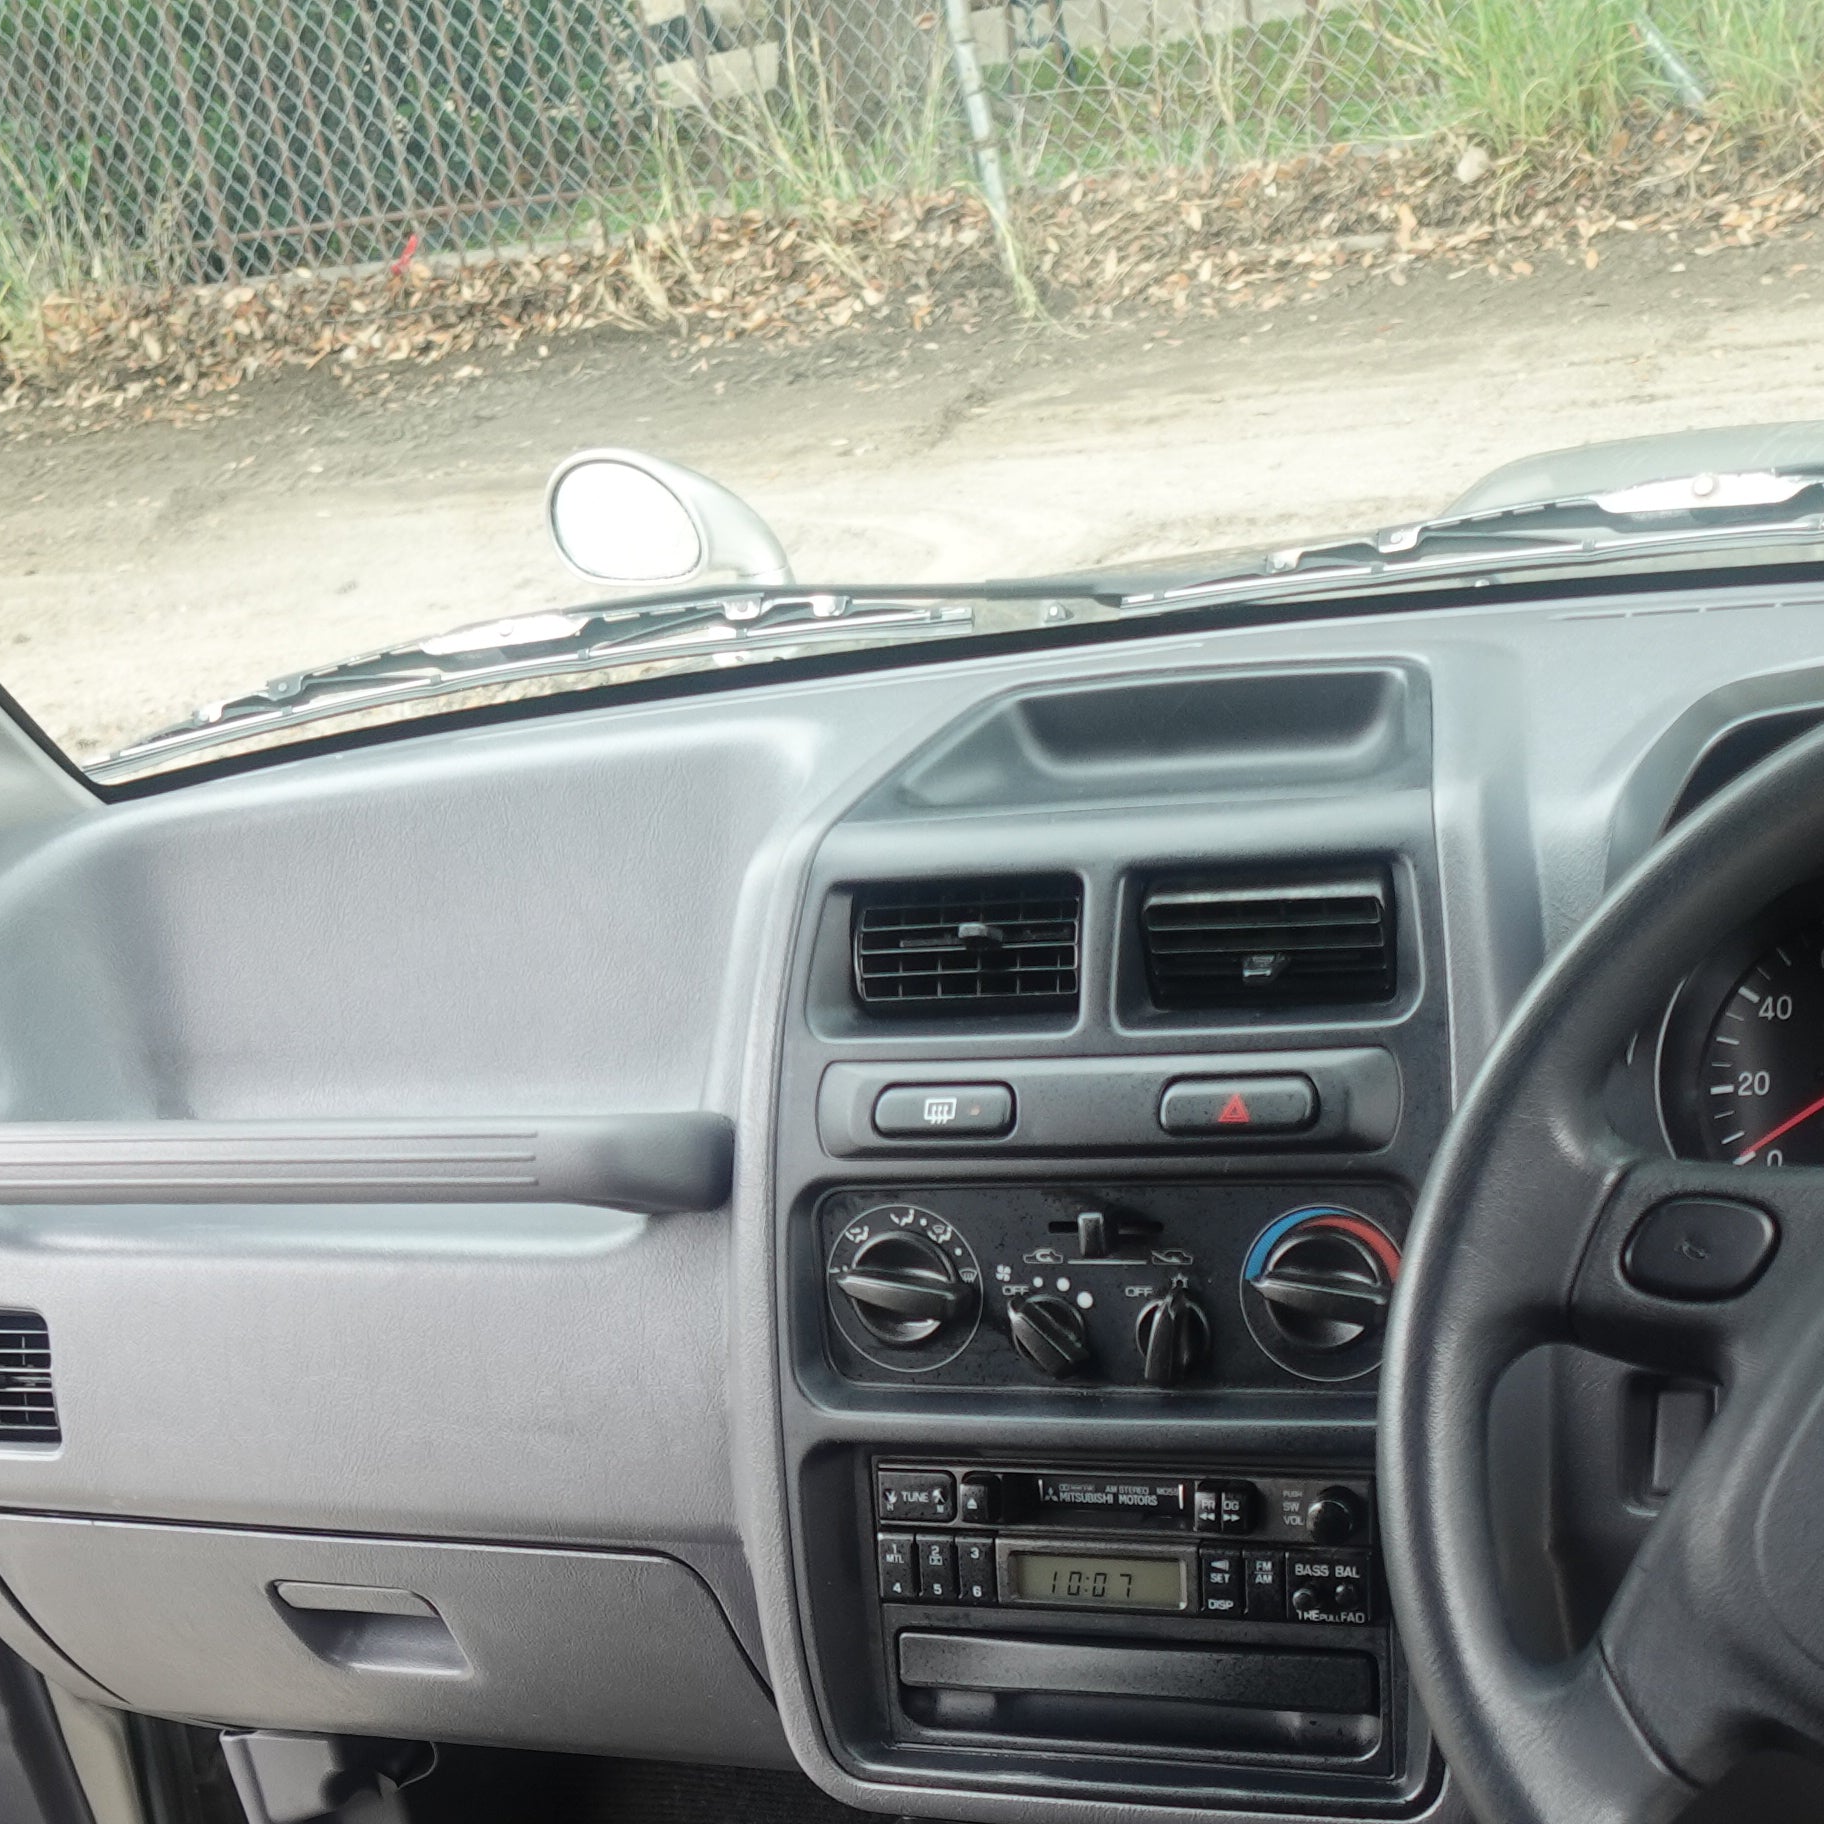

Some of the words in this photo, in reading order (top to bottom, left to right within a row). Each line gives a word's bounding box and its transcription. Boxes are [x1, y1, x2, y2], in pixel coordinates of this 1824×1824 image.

[1758, 996, 1792, 1021] 40
[1737, 1071, 1770, 1096] 20
[1766, 1150, 1783, 1167] 0
[1002, 1285, 1029, 1296] OFF
[1125, 1286, 1153, 1297] OFF
[901, 1491, 929, 1503] TUNE
[1059, 1492, 1114, 1505] MITSUBISHI
[1119, 1494, 1158, 1506] MOTORS
[1283, 1502, 1299, 1512] SW
[1283, 1515, 1304, 1526] VOL
[931, 1545, 940, 1557] 2
[970, 1547, 980, 1559] 3
[886, 1554, 904, 1564] MTL
[1256, 1560, 1272, 1571] FM
[1295, 1563, 1329, 1577] BASS
[1335, 1566, 1360, 1579] BAL
[1052, 1571, 1132, 1597] 10:07
[1210, 1573, 1230, 1584] SET
[1255, 1574, 1273, 1584] AM
[892, 1582, 902, 1593] 4
[933, 1583, 942, 1595] 5
[972, 1585, 982, 1597] 6
[1208, 1599, 1234, 1610] DISP
